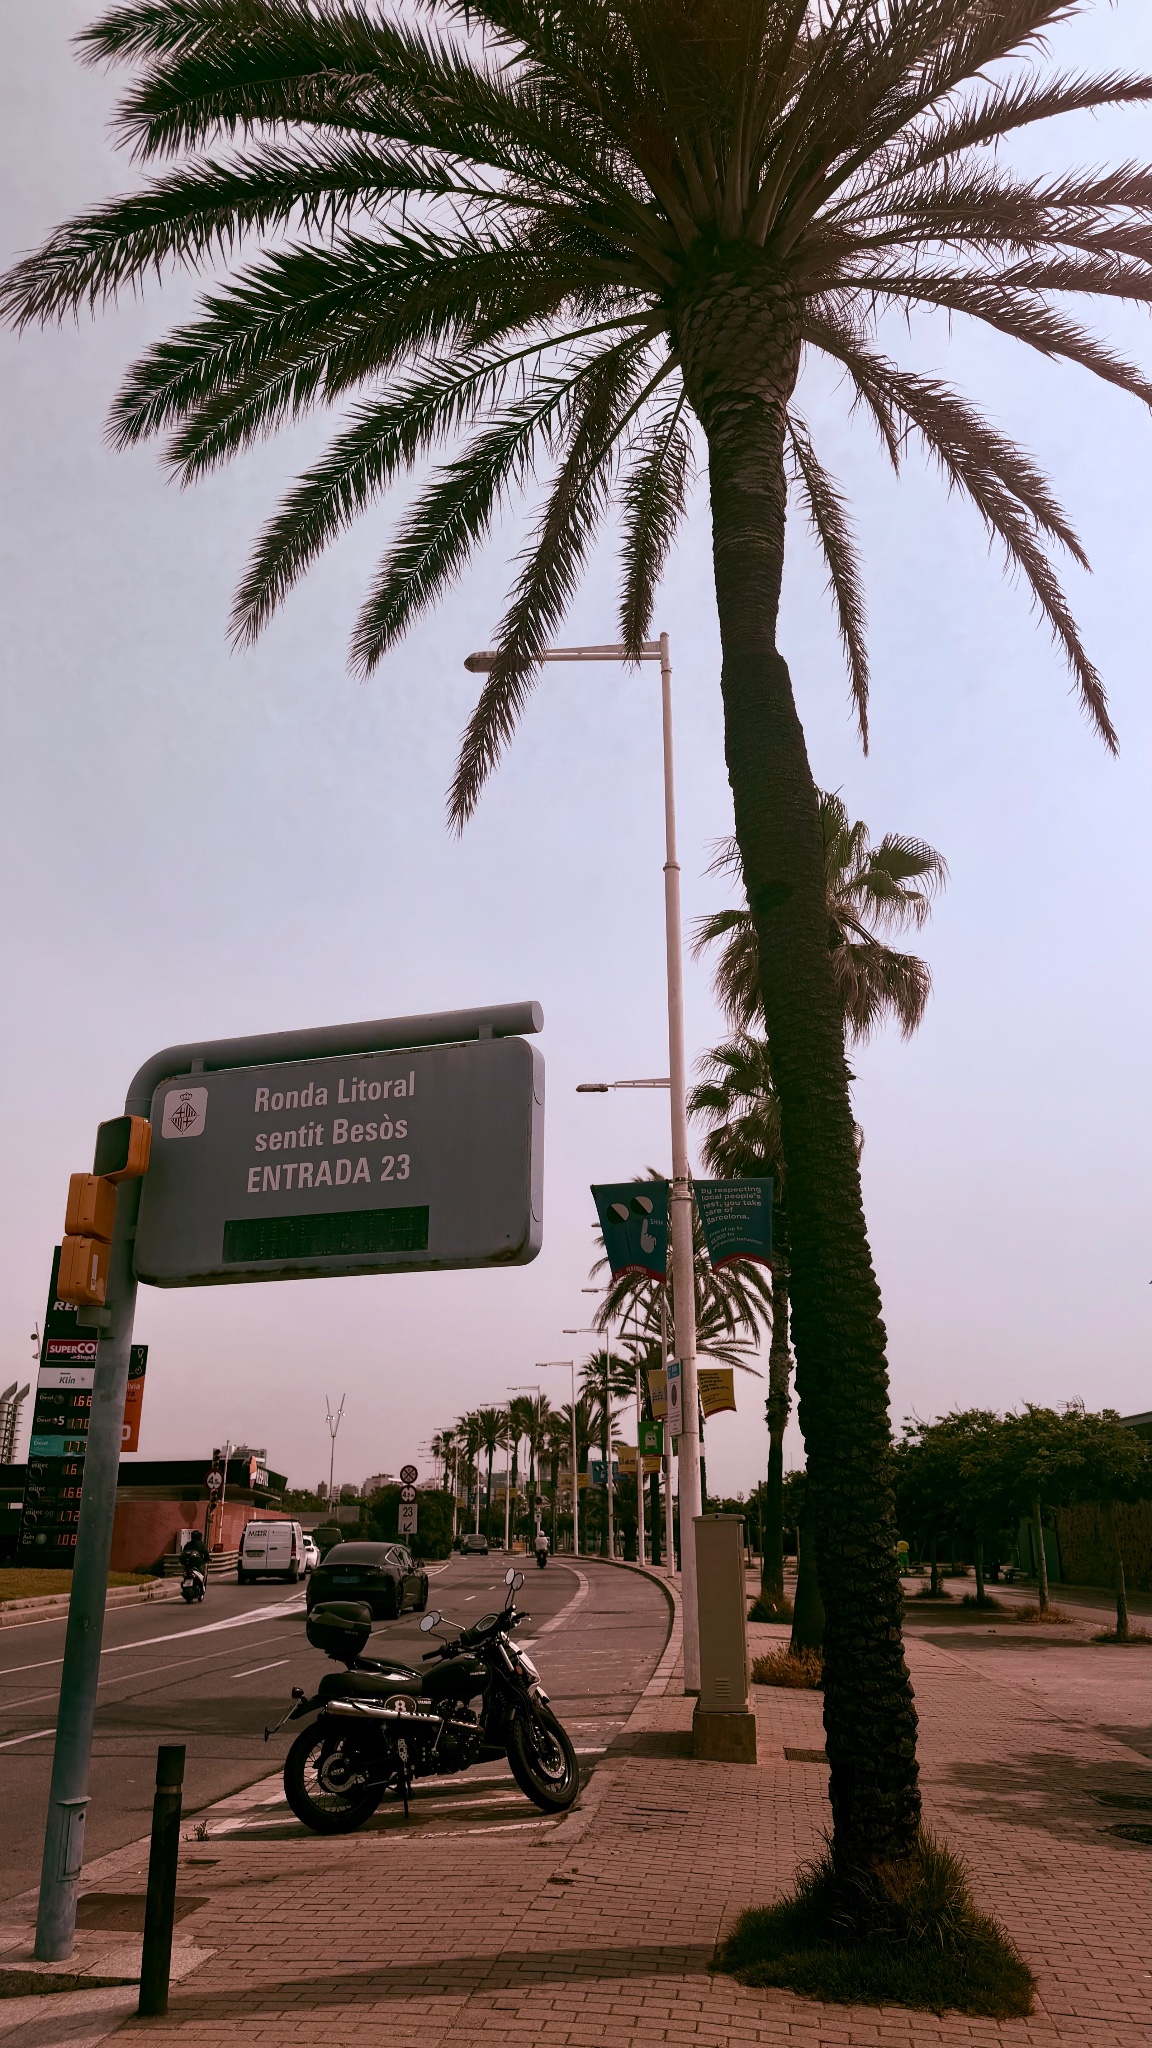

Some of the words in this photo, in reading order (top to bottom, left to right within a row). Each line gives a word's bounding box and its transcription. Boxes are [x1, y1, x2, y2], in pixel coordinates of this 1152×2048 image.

[254, 1082, 328, 1113] Ronda
[337, 1071, 416, 1104] Litoral
[254, 1121, 324, 1152] sentit
[332, 1114, 408, 1145] Besòs
[247, 1157, 371, 1193] ENTRADA
[380, 1153, 411, 1182] 23
[714, 1186, 762, 1194] respecting
[701, 1193, 722, 1201] local
[703, 1201, 722, 1209] rest,
[705, 1208, 722, 1217] care
[706, 1214, 750, 1225] Barcelona.
[403, 1507, 413, 1517] 23
[394, 1700, 407, 1712] 8
